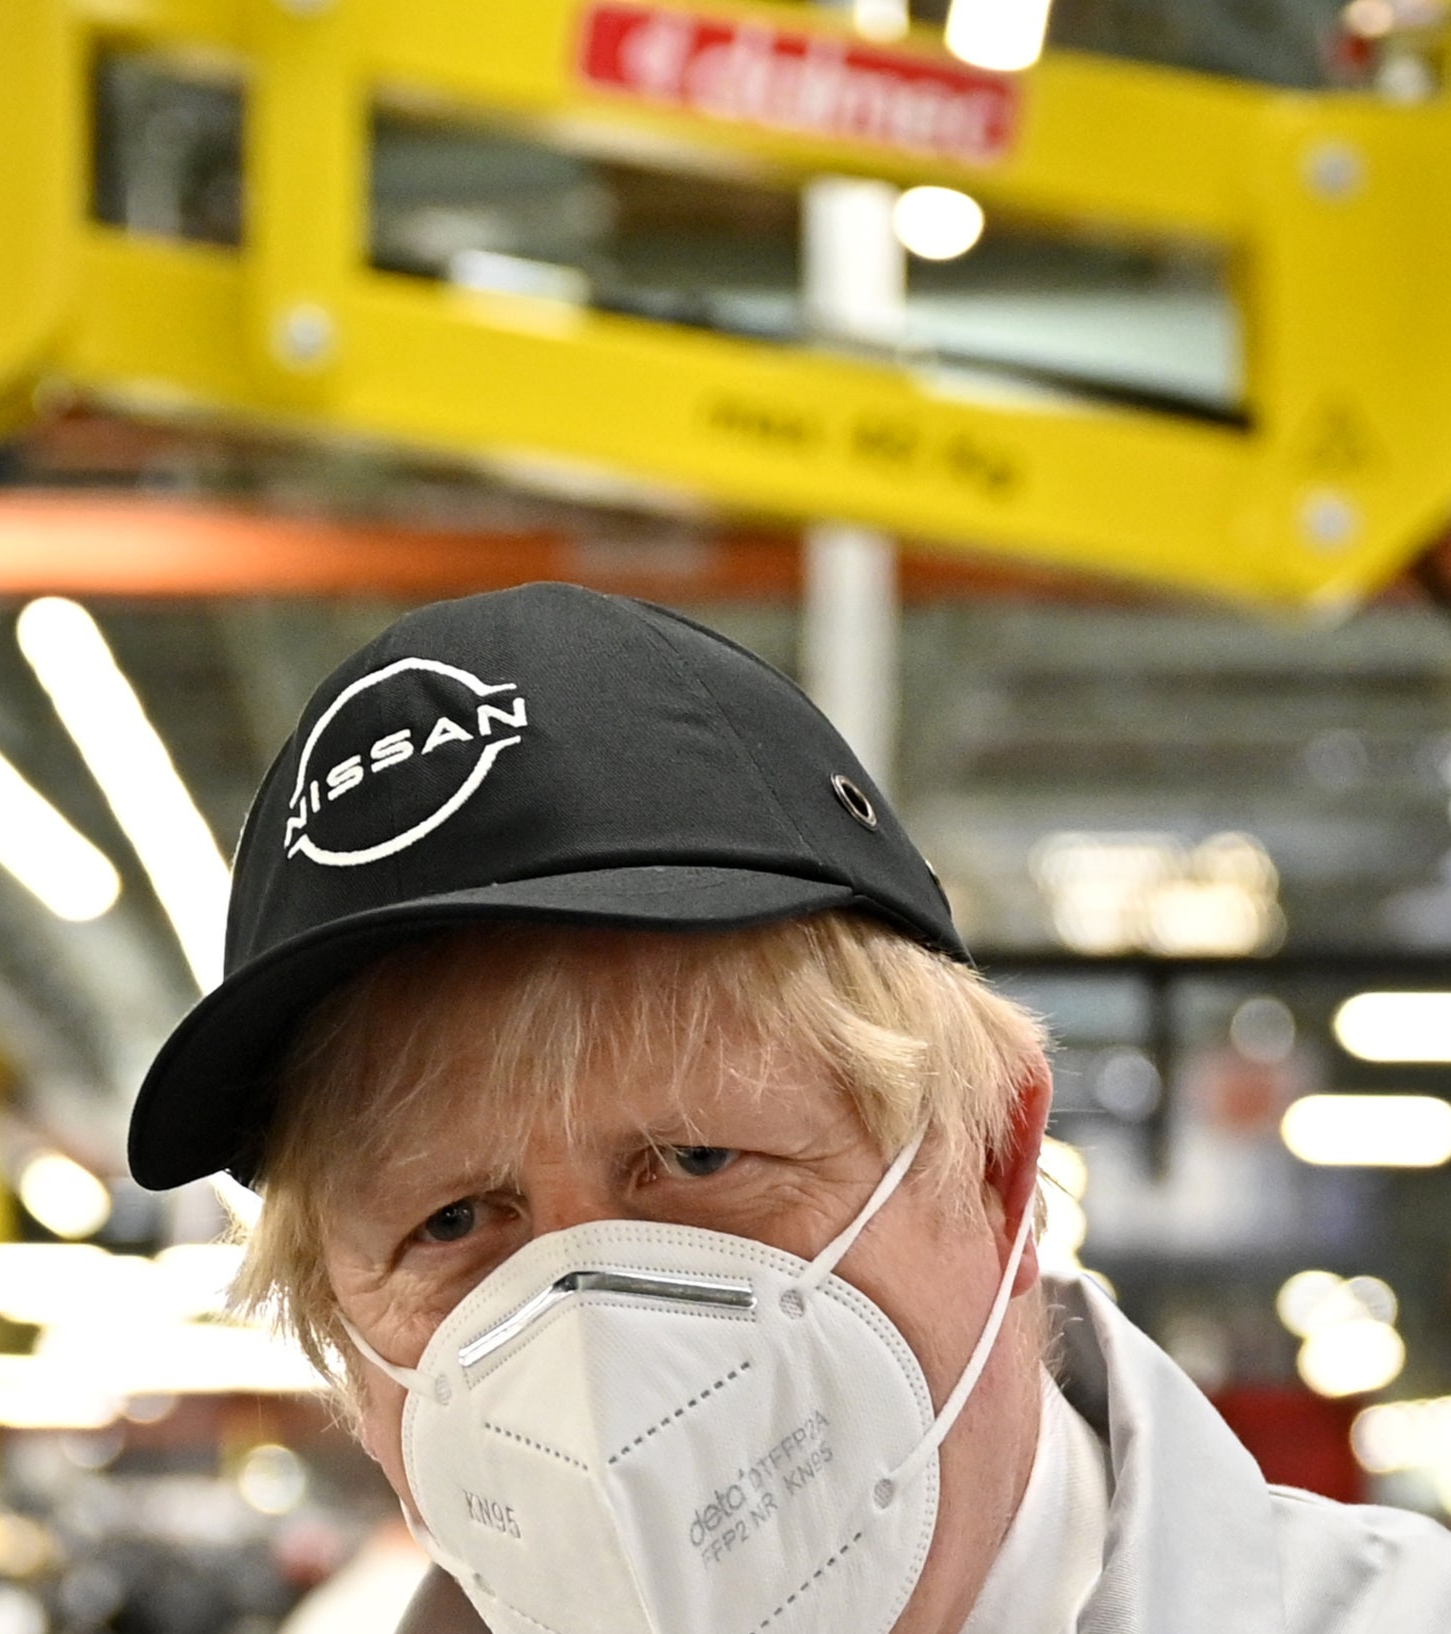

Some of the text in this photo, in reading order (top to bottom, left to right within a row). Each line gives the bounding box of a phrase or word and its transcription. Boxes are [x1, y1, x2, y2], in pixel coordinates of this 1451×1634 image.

[284, 697, 528, 829] NISSAN
[701, 1520, 749, 1569] FFP2
[750, 1492, 778, 1528] NR
